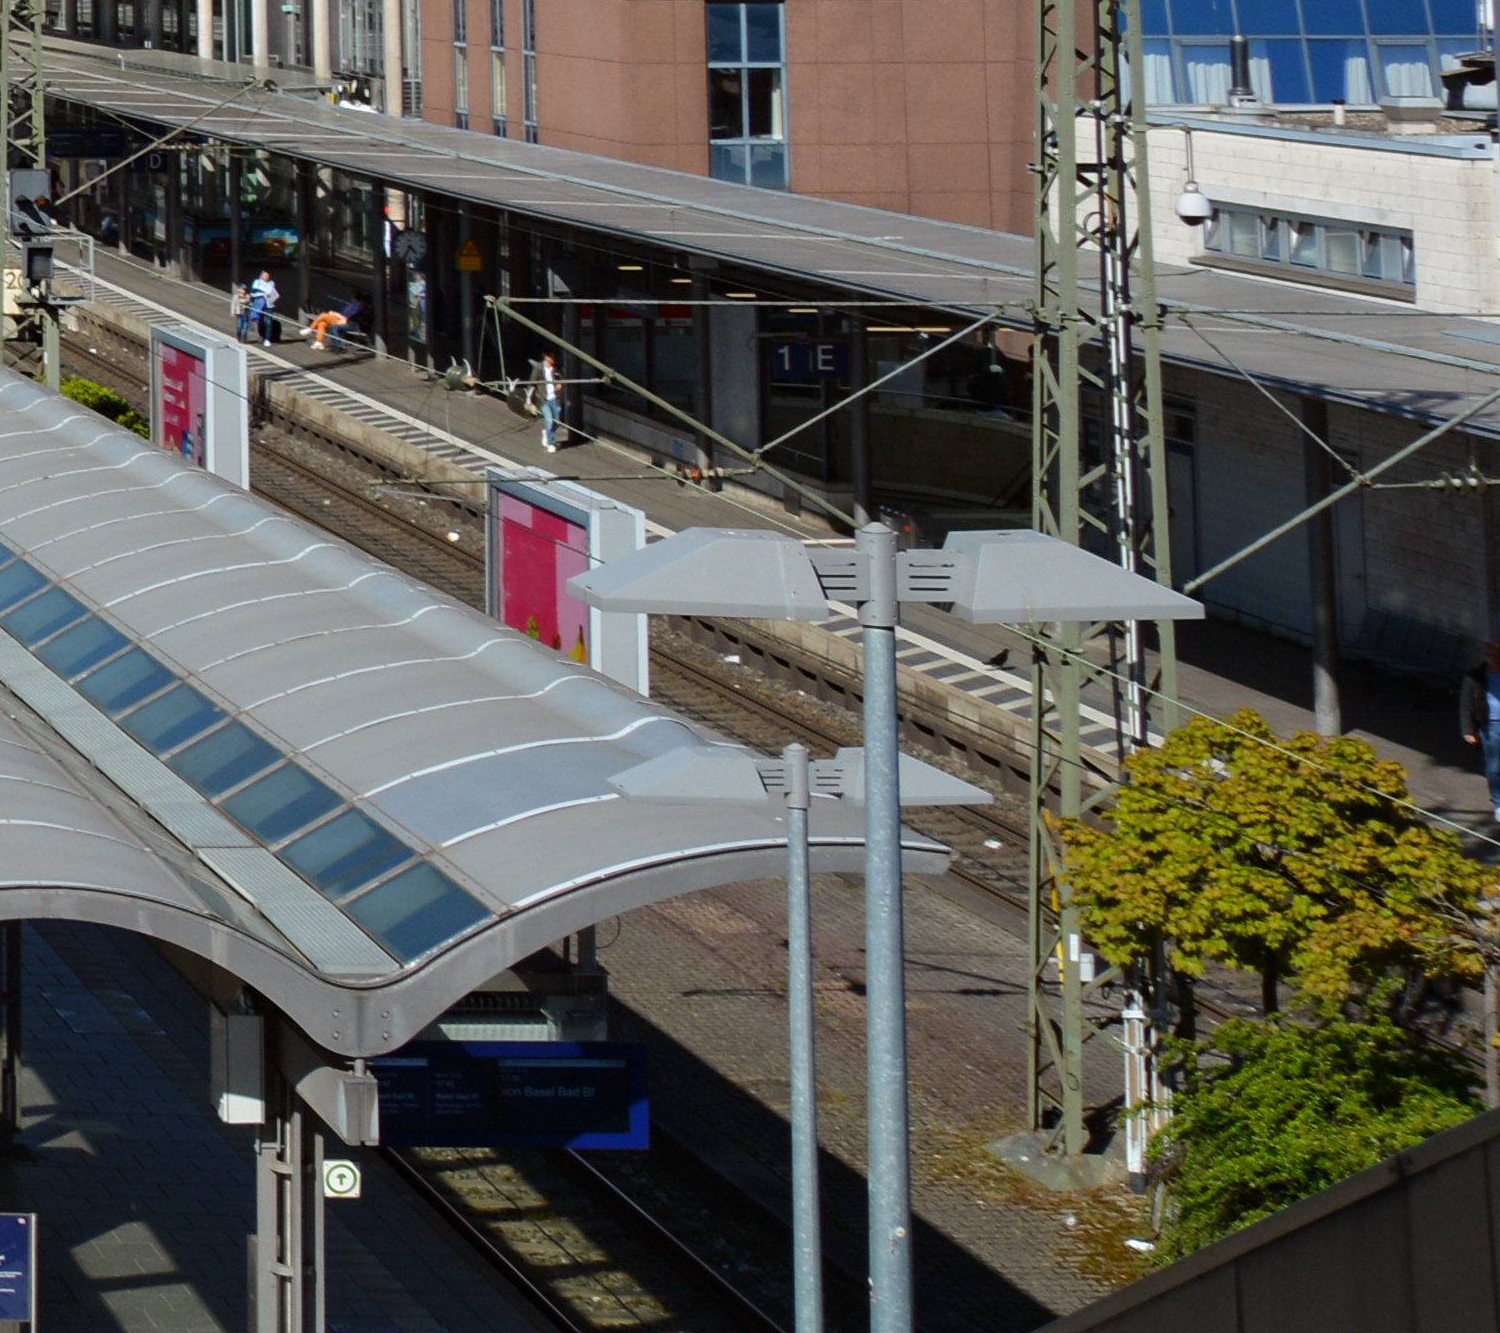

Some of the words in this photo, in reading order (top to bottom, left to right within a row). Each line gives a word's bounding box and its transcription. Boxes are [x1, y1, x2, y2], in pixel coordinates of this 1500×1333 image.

[149, 153, 162, 169] D
[777, 344, 791, 372] 1
[816, 344, 835, 371] E
[500, 1088, 521, 1097] von
[524, 1085, 555, 1097] Basel
[558, 1086, 580, 1098] Bad
